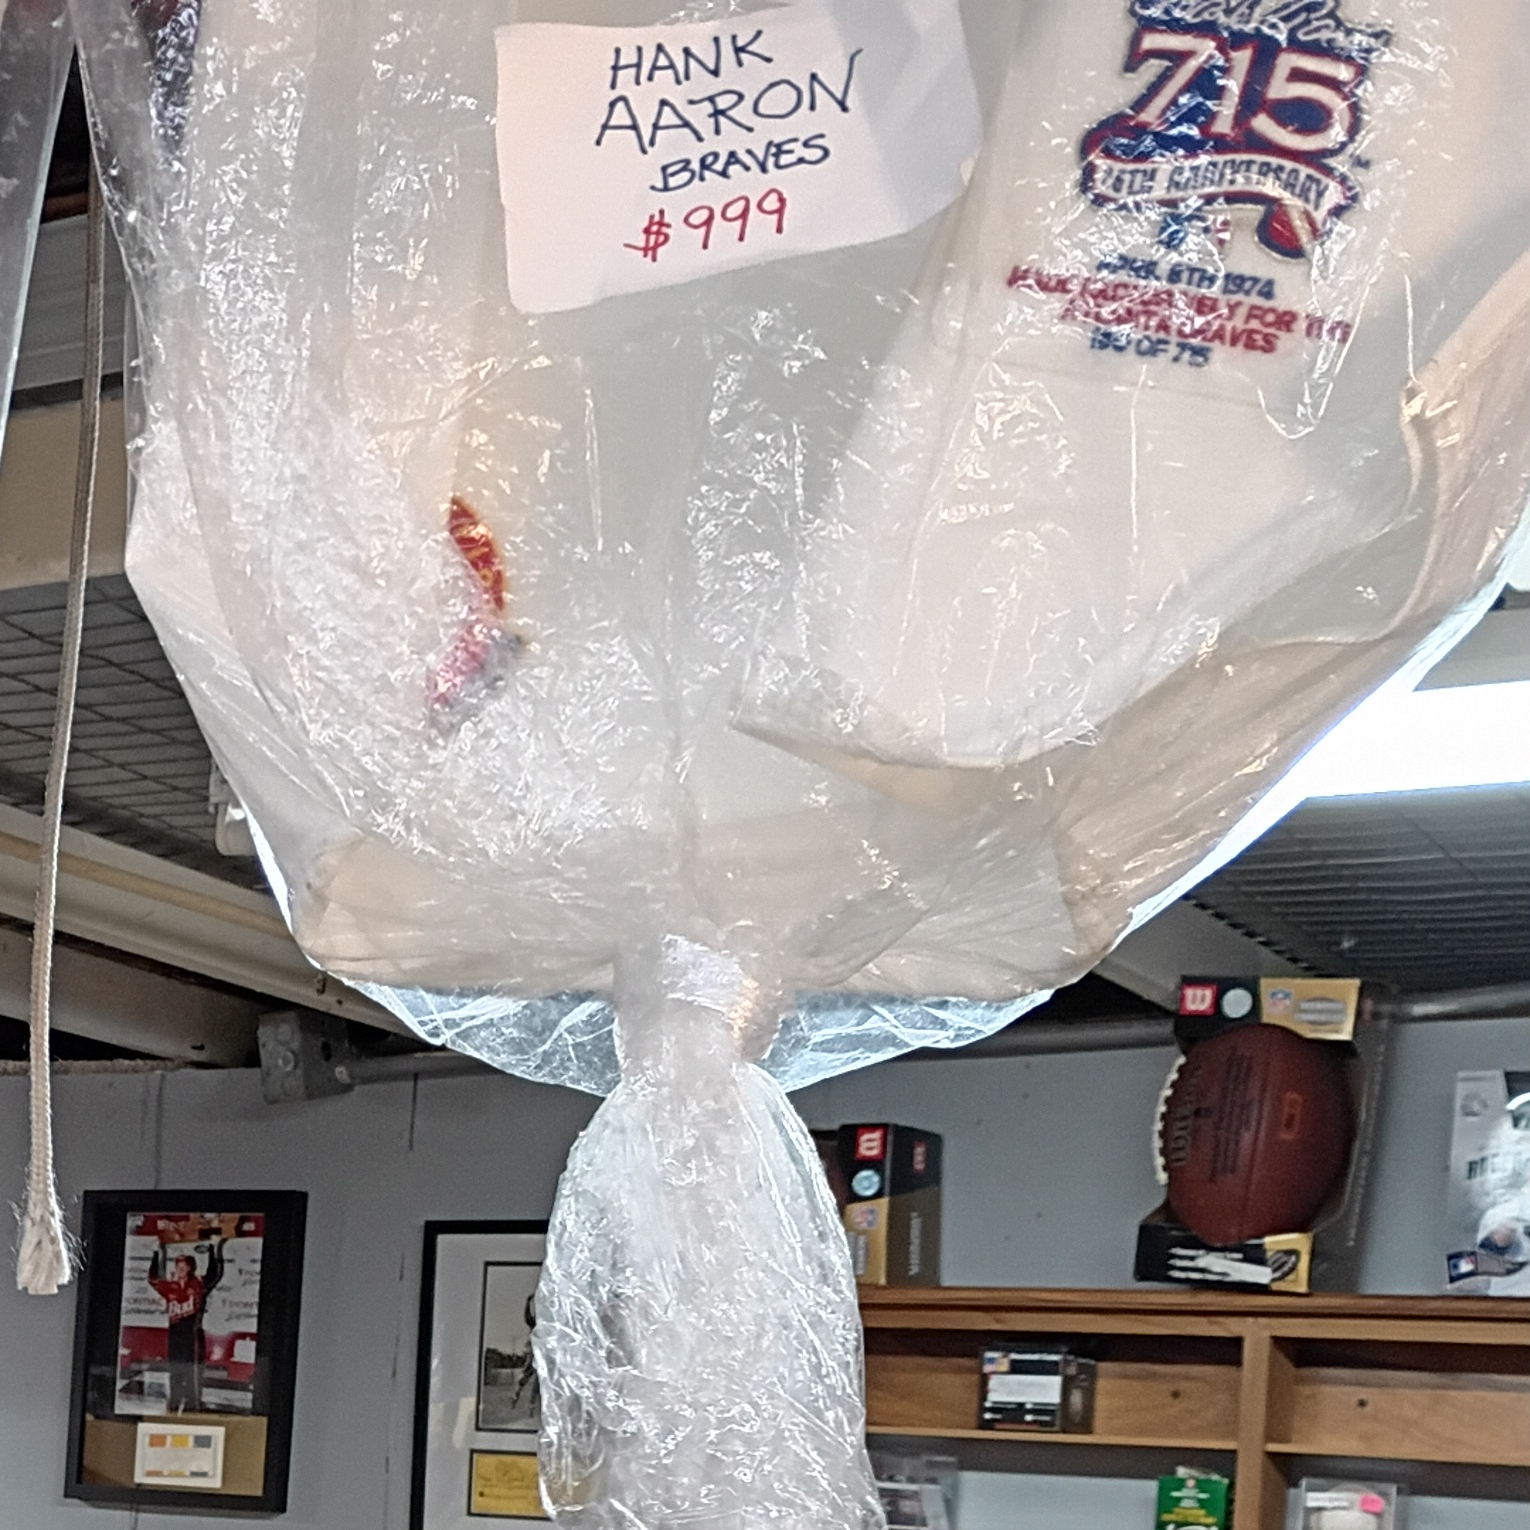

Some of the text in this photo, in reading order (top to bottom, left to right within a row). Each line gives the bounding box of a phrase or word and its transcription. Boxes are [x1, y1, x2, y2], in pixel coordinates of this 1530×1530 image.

[610, 29, 774, 90] HANK
[595, 47, 863, 155] AARON
[1125, 28, 1367, 158] 715
[649, 133, 831, 192] BRAVES
[623, 187, 787, 262] $999
[1222, 271, 1276, 300] 1974
[1177, 322, 1279, 354] BRAVES
[1244, 304, 1298, 333] FOR
